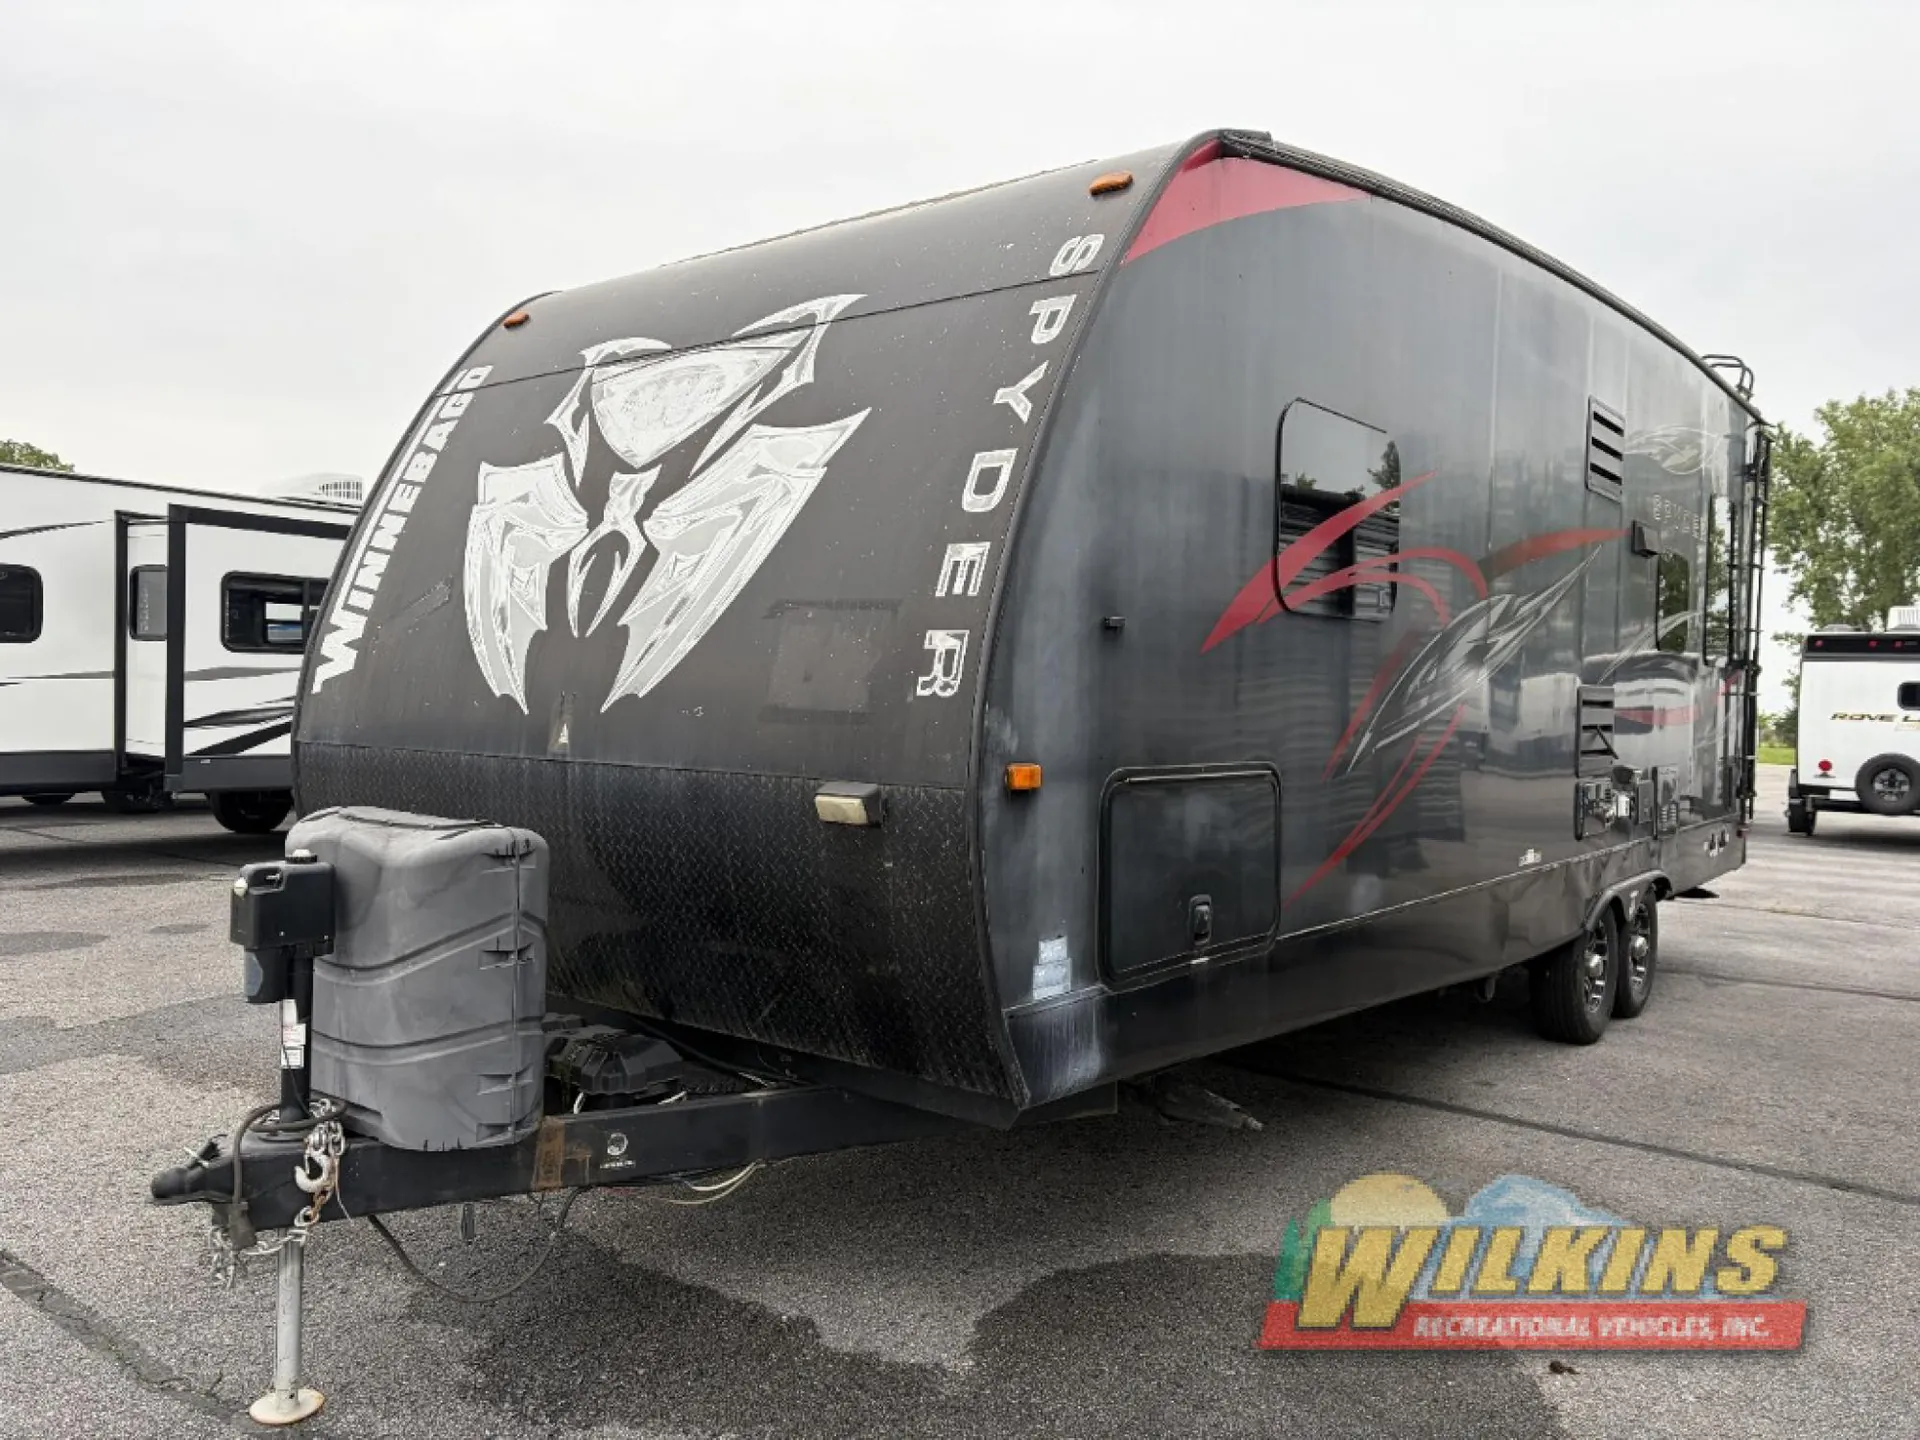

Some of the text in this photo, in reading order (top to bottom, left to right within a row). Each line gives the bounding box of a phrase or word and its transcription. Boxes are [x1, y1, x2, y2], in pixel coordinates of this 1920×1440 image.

[311, 365, 494, 694] WINNEBAGO
[916, 233, 1105, 698] SPYDER
[1830, 712, 1897, 722] ROVE
